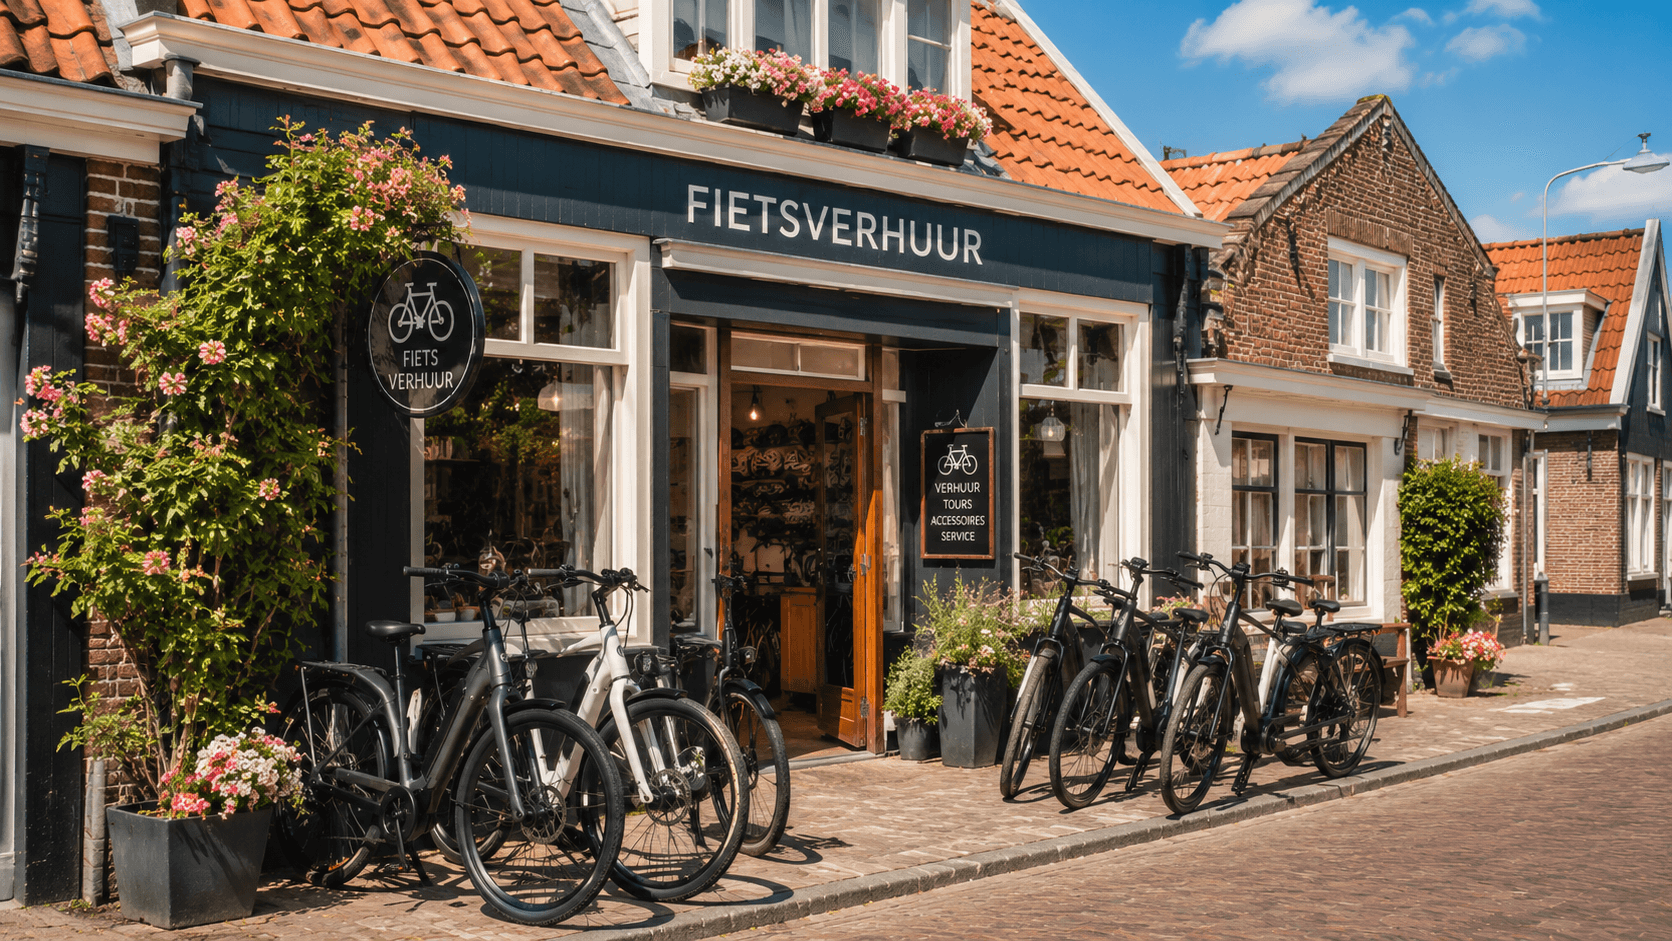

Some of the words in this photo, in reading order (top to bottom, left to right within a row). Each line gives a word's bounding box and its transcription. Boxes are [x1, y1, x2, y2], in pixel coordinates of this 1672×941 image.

[687, 184, 983, 265] FIETSVERHUUR
[403, 349, 438, 367] FIETS
[388, 371, 453, 390] VERHUUR
[934, 482, 980, 493] VERHUUR
[943, 499, 972, 510] TOURS
[930, 515, 985, 526] ACCESSOIRES
[941, 531, 975, 542] SERVICE
